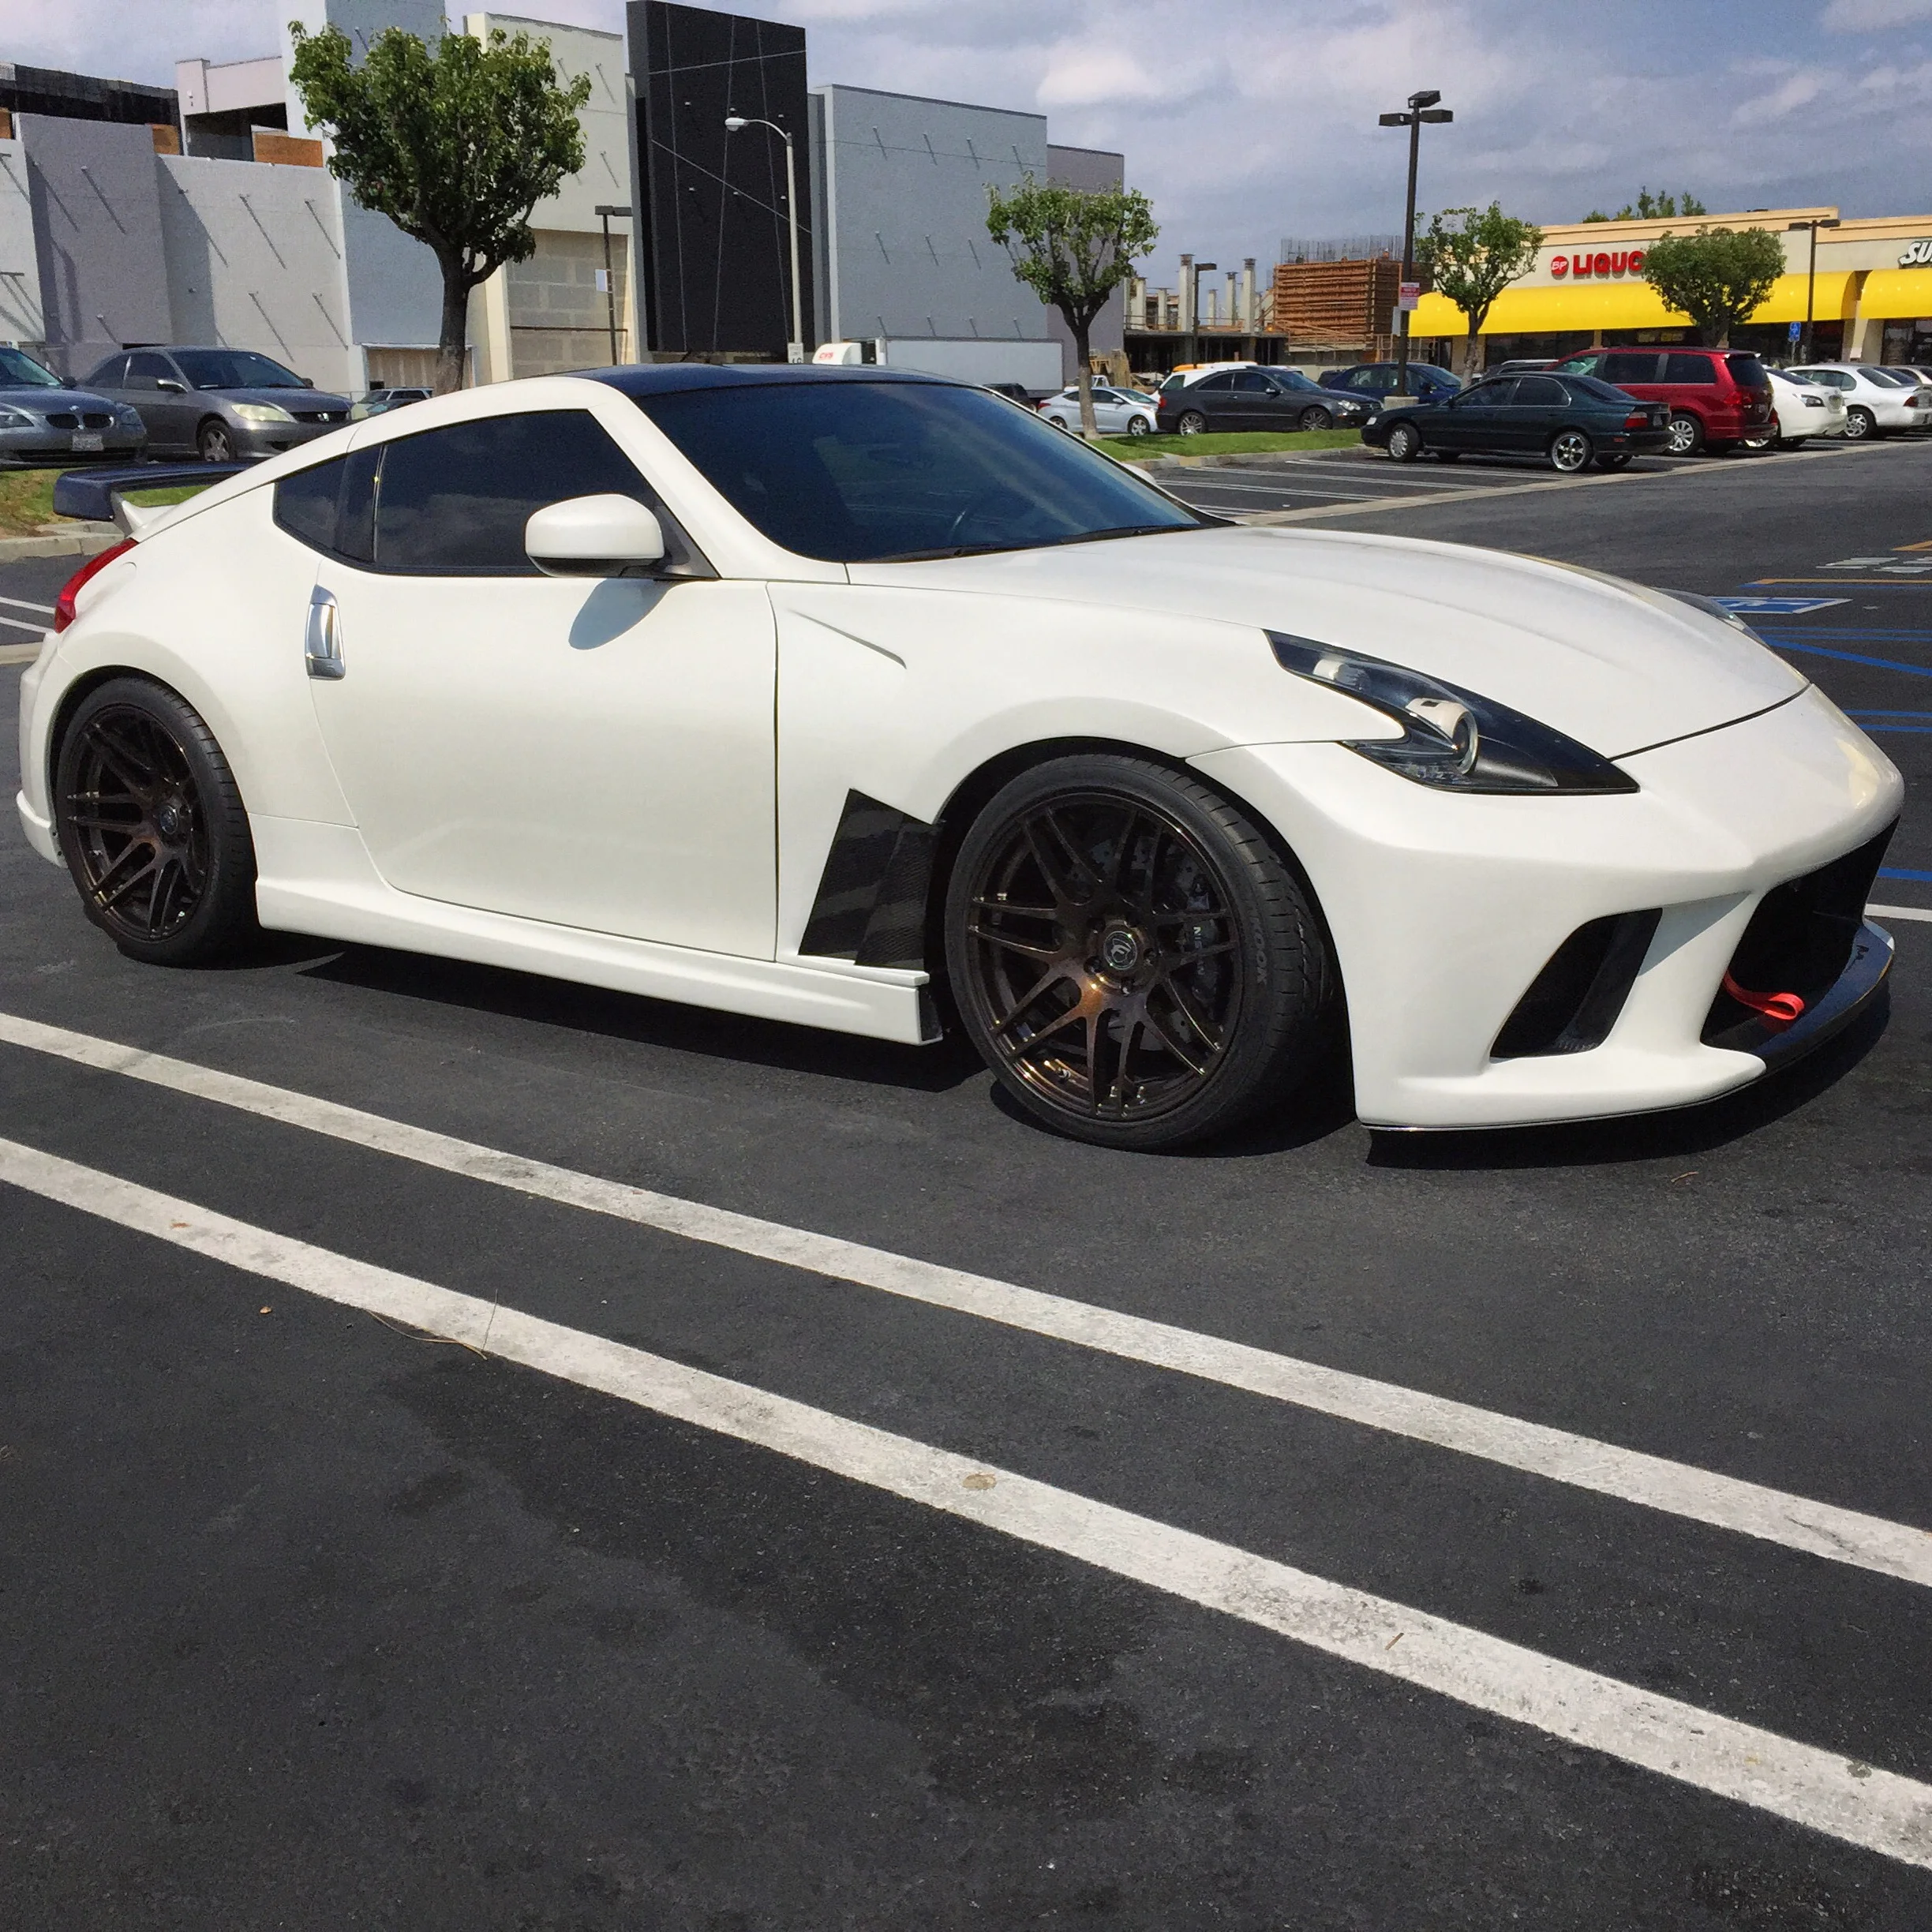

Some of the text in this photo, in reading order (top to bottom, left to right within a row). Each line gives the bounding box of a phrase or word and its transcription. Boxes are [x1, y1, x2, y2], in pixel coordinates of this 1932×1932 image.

[1573, 250, 1645, 275] LIQUO
[1899, 241, 1932, 264] SU
[1193, 927, 1206, 975] NISN
